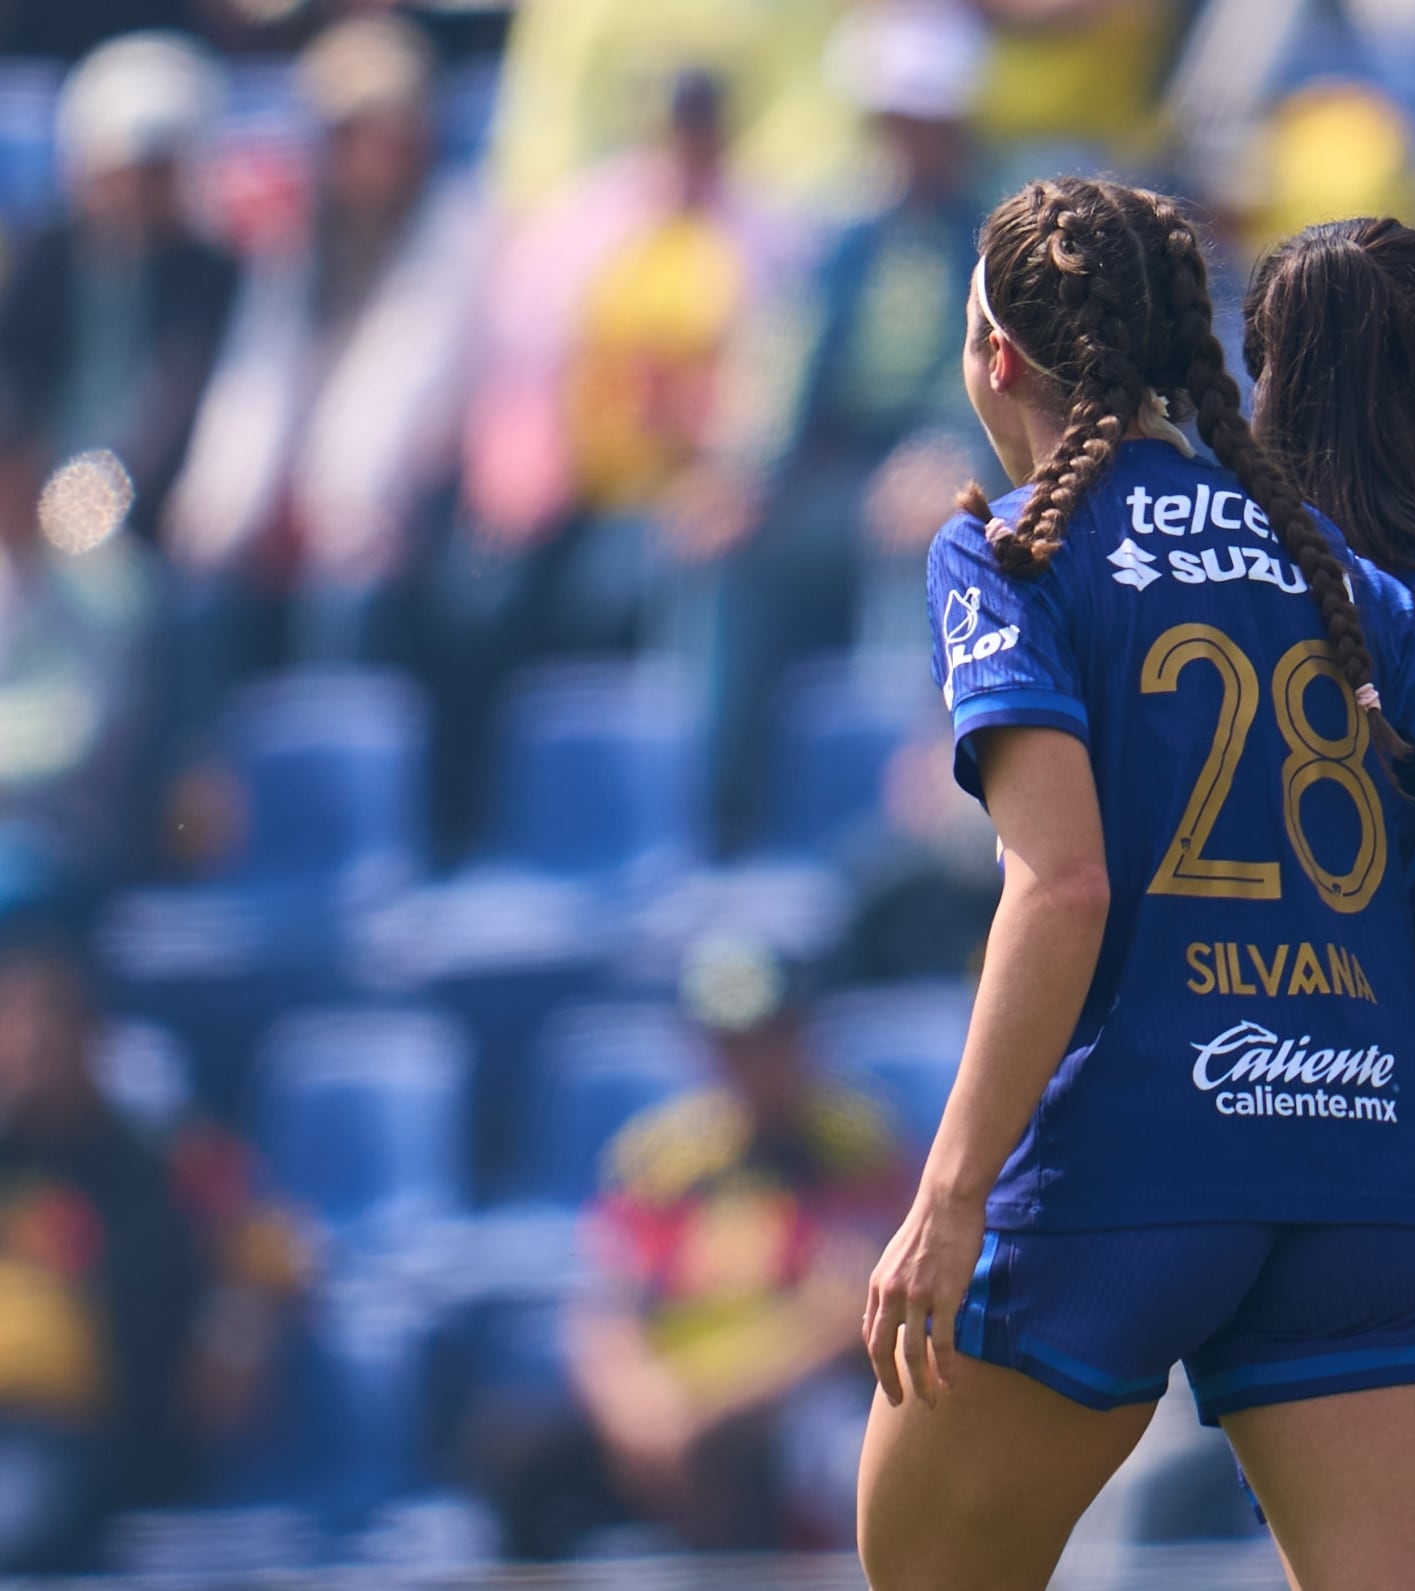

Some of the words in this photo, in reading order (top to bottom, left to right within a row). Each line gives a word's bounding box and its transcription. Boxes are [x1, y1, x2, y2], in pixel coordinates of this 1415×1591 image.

[1126, 484, 1279, 544] telce
[1140, 623, 1387, 914] 28
[1185, 941, 1378, 1005] SILVANA
[1190, 1019, 1396, 1091] Caliente
[1215, 1085, 1398, 1123] caliente.mx
